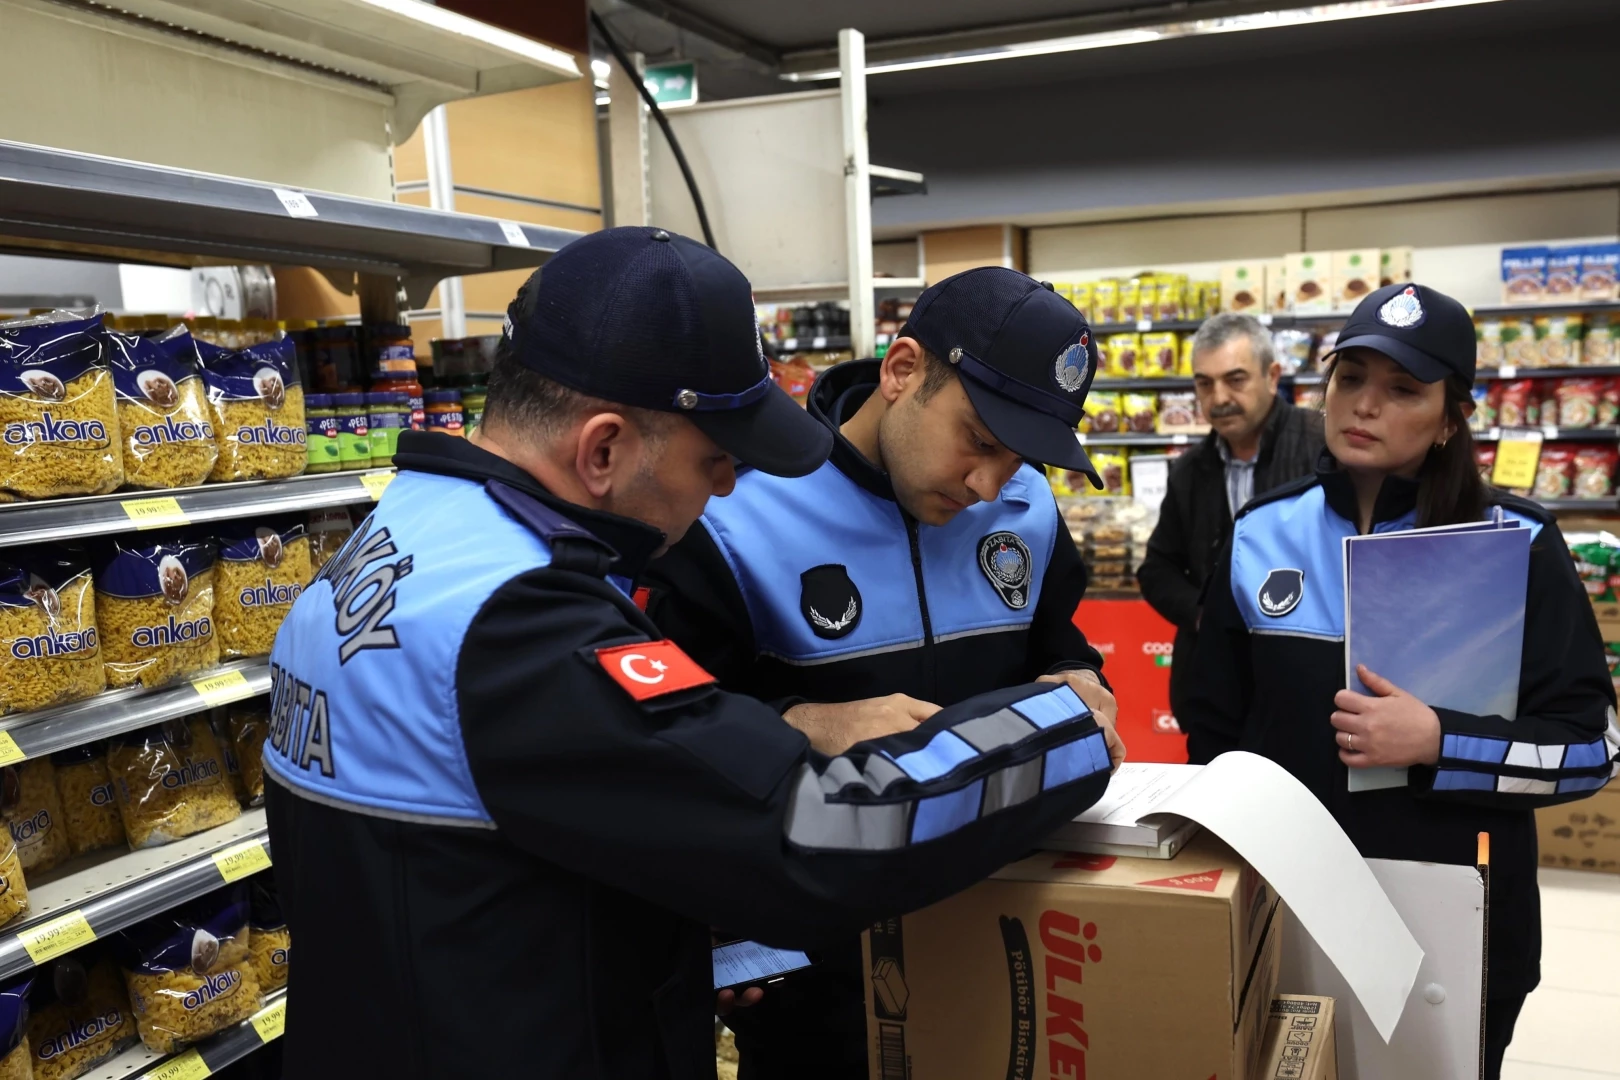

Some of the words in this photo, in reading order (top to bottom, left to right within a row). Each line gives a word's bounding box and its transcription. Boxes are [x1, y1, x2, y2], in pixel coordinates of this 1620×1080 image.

[4, 412, 107, 445] ankara
[135, 416, 215, 446] ankara
[237, 418, 306, 445] ankara
[321, 418, 336, 431] PES
[988, 535, 1016, 548] ZABITA
[240, 578, 304, 608] ankara
[11, 624, 97, 660] ankara
[132, 614, 213, 648] ankara
[161, 757, 221, 790] ankara
[9, 808, 50, 843] kara
[34, 927, 61, 944] 19,99
[183, 969, 241, 1011] ankara
[1011, 949, 1031, 1014] Pötibör
[1039, 909, 1103, 1080] ÜLKE
[38, 1006, 123, 1060] ankara
